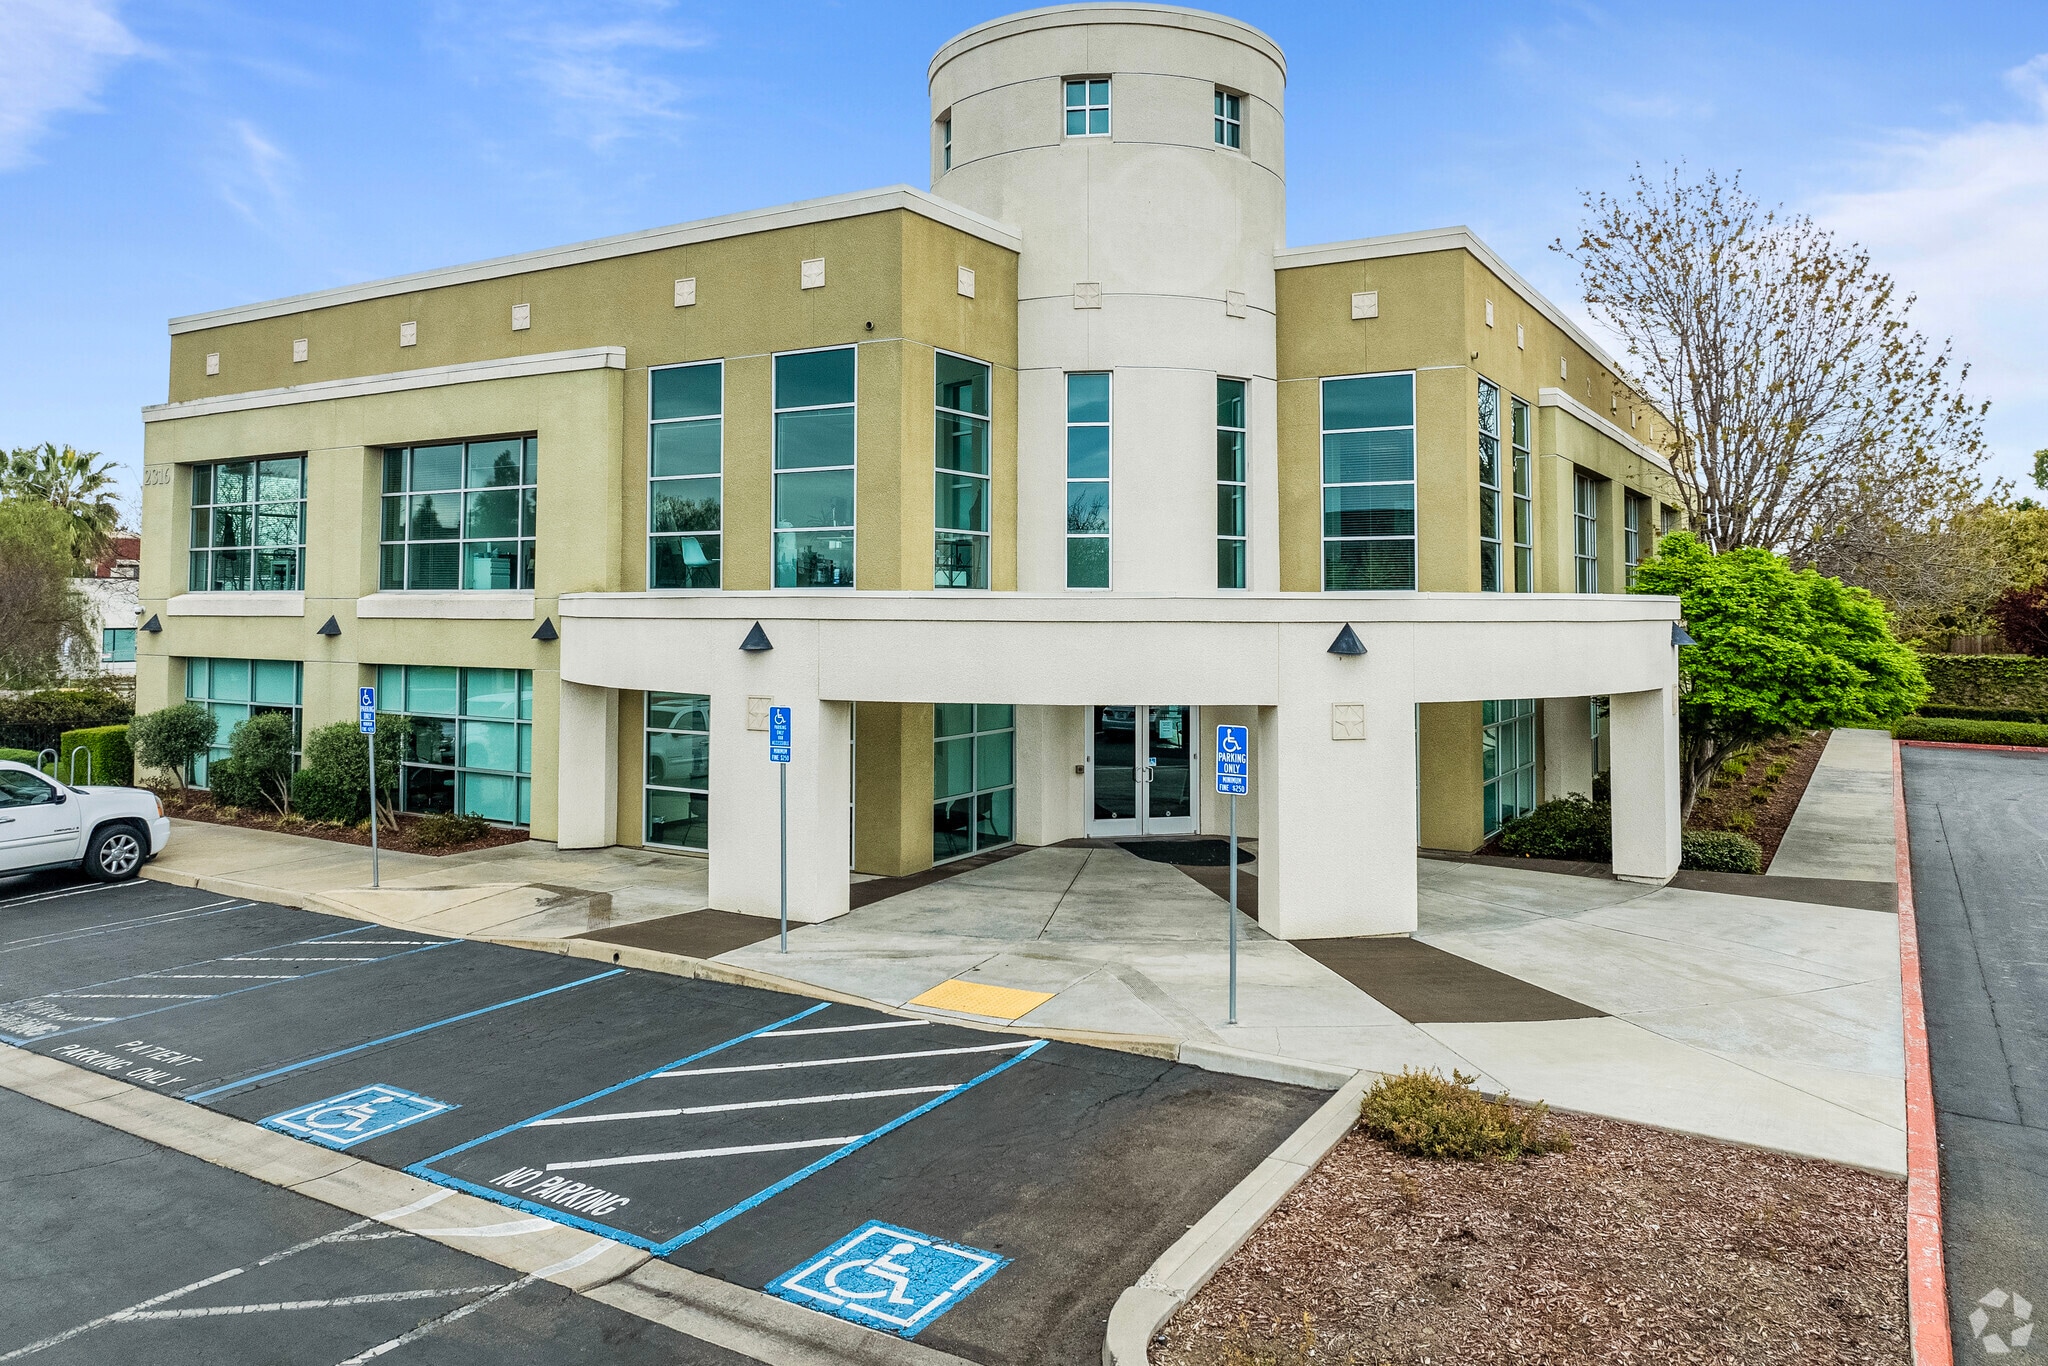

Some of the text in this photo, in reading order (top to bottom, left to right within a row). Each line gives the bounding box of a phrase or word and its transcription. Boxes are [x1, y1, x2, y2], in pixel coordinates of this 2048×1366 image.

[1218, 752, 1247, 764] PARKING
[1223, 763, 1241, 774] ONLY
[1222, 776, 1242, 784] MINIMUM
[1219, 783, 1246, 793] FINE $250
[114, 1040, 204, 1067] PATIENT
[51, 1043, 187, 1087] PARKING ONLY
[488, 1166, 631, 1216] NO PARKING
